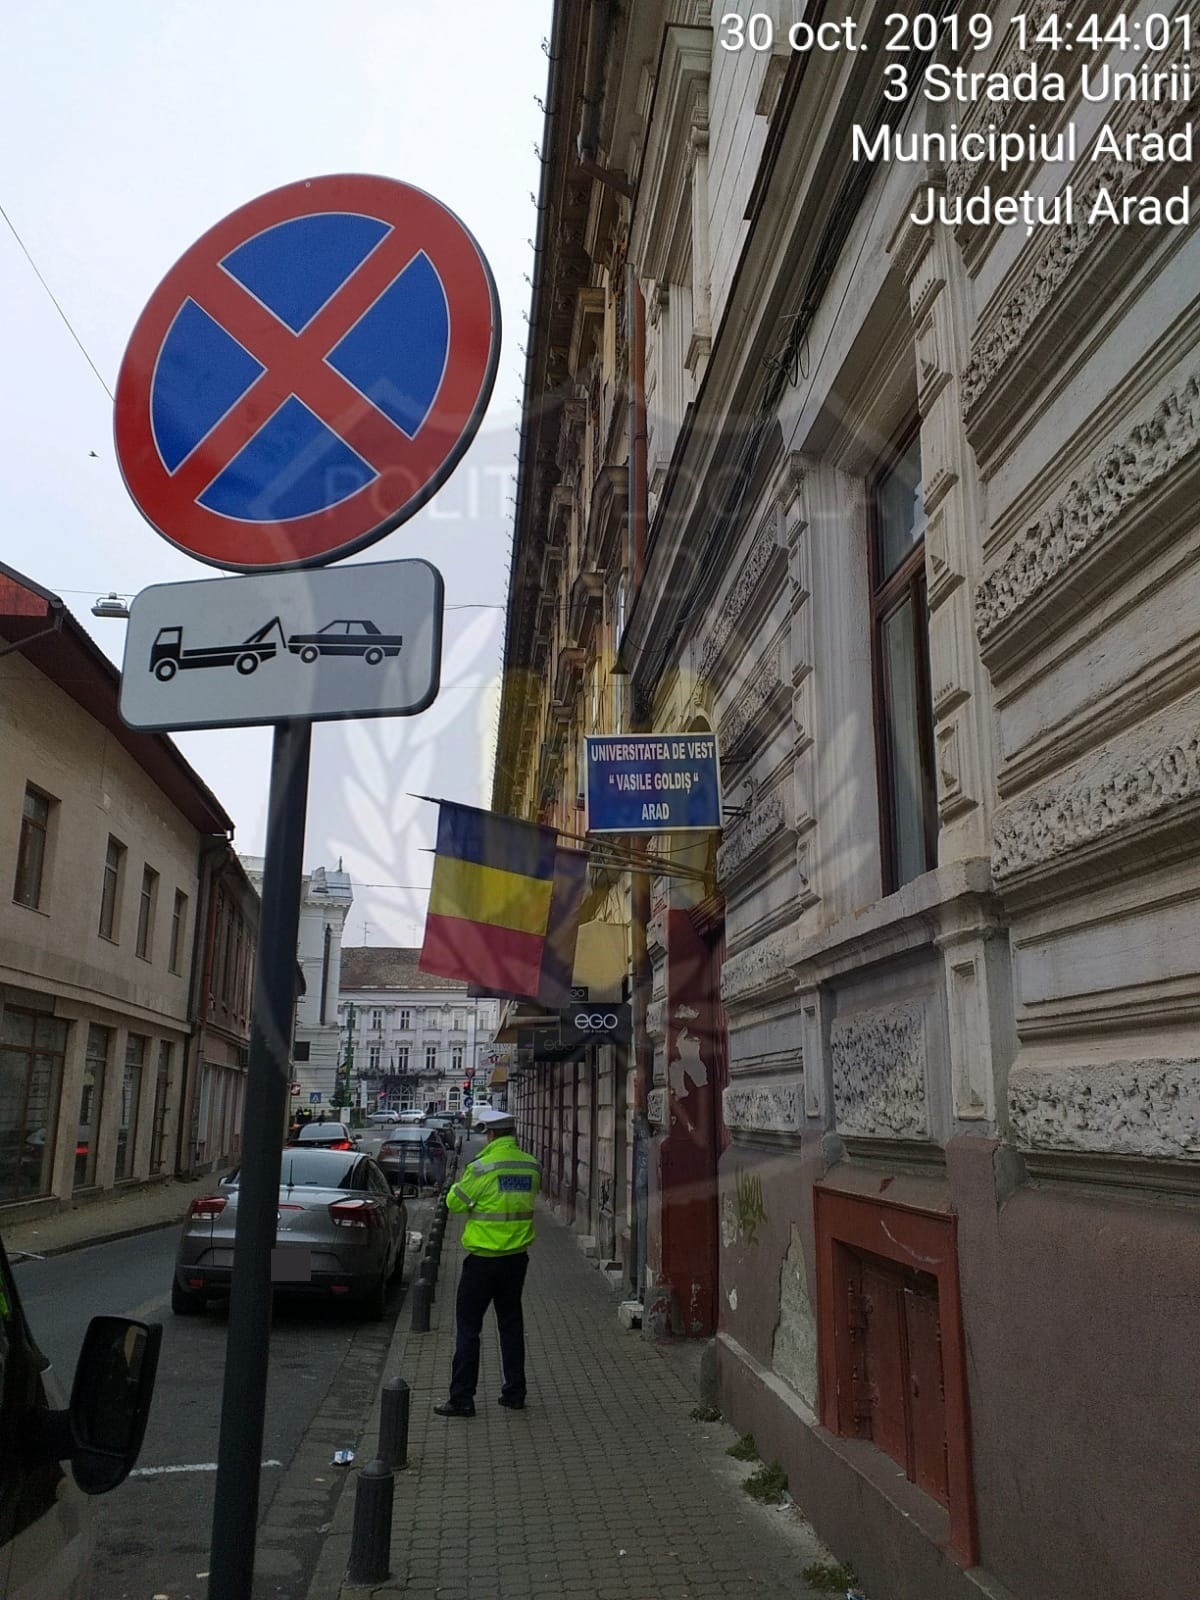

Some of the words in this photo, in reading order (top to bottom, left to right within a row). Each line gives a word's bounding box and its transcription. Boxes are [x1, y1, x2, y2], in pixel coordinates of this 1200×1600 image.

[591, 743, 670, 761] UNIVERSITATEA
[672, 743, 686, 760] DE
[688, 741, 714, 759] VEST
[641, 803, 670, 821] ARAD
